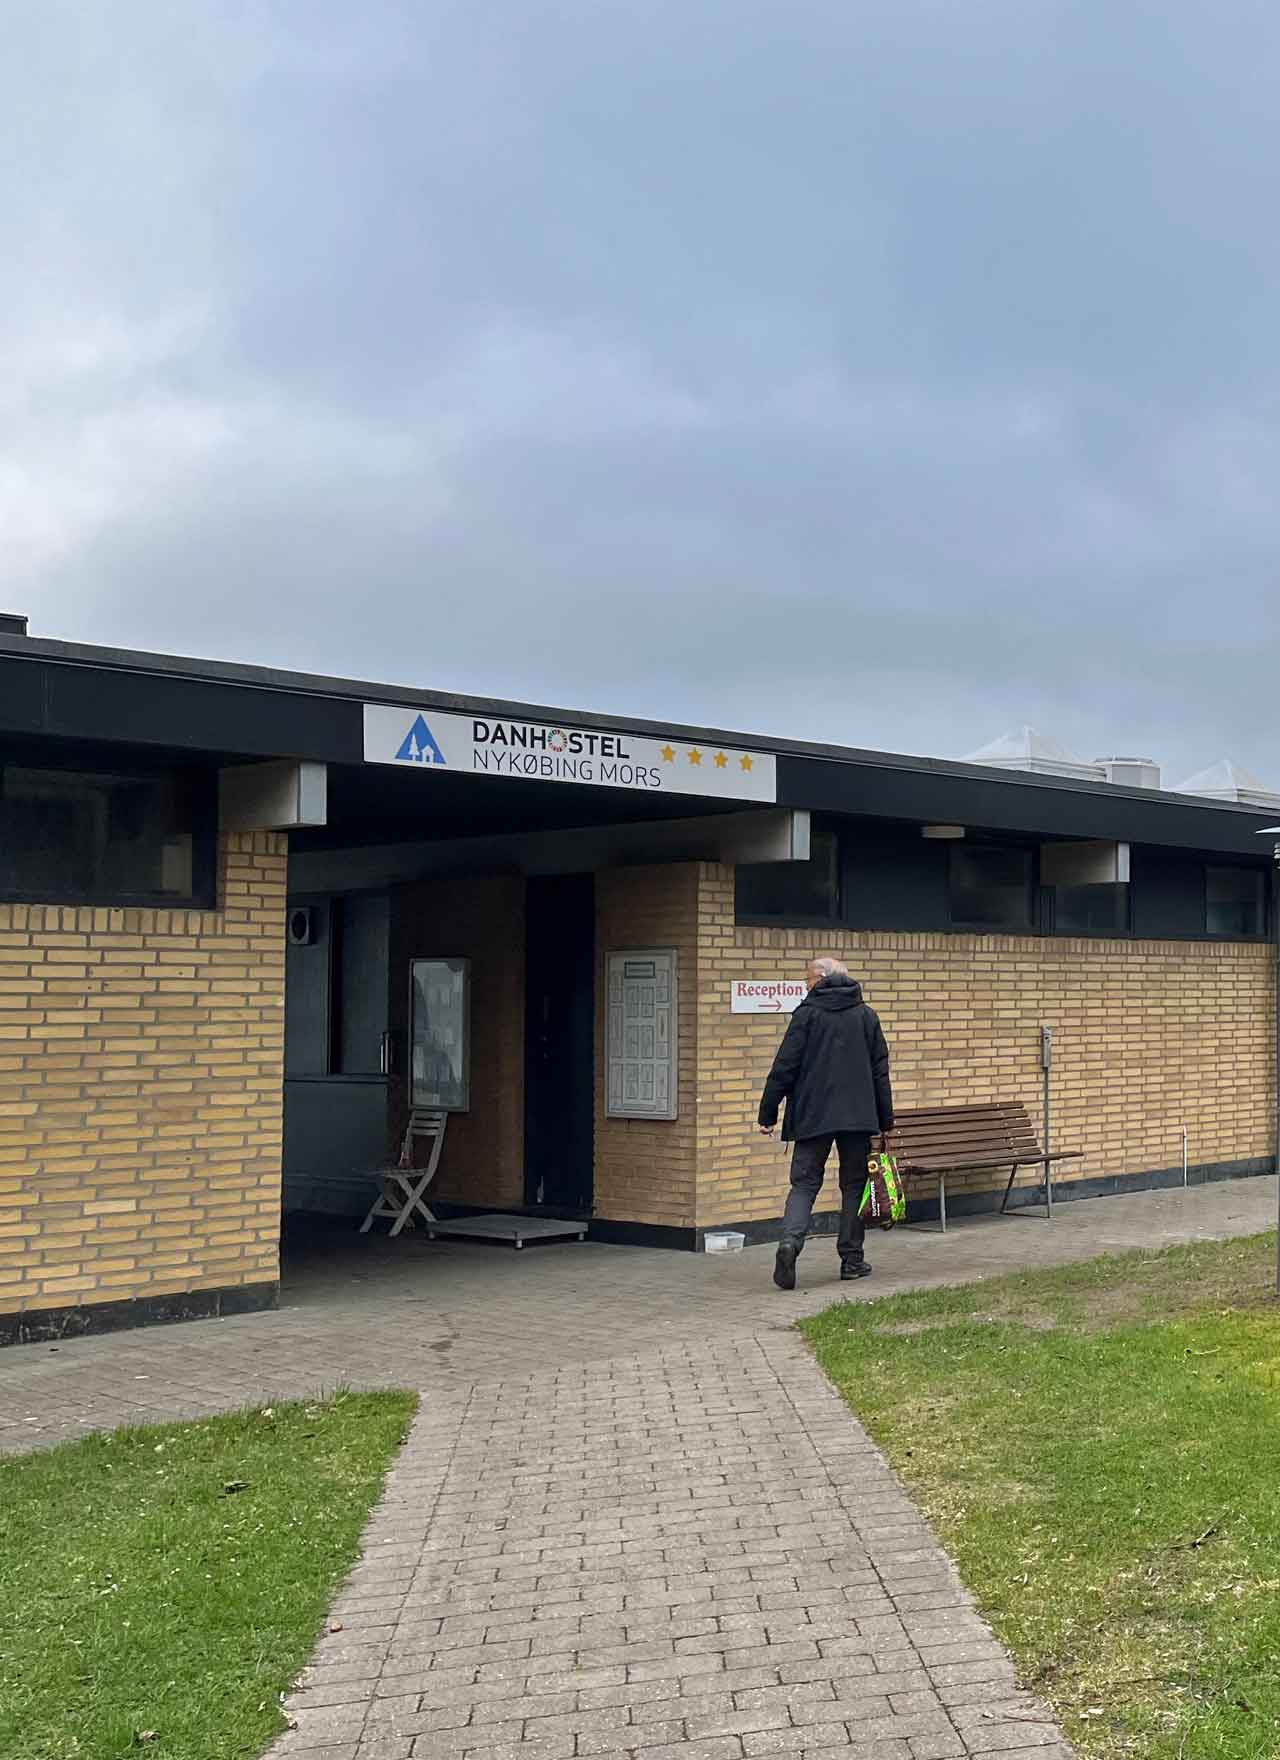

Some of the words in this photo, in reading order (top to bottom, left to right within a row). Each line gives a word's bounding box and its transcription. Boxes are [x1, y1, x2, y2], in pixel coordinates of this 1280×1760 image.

[473, 720, 630, 759] DANHOSTEL
[473, 749, 593, 780] NYKØBING
[600, 762, 661, 787] MORS
[737, 983, 803, 999] Reception
